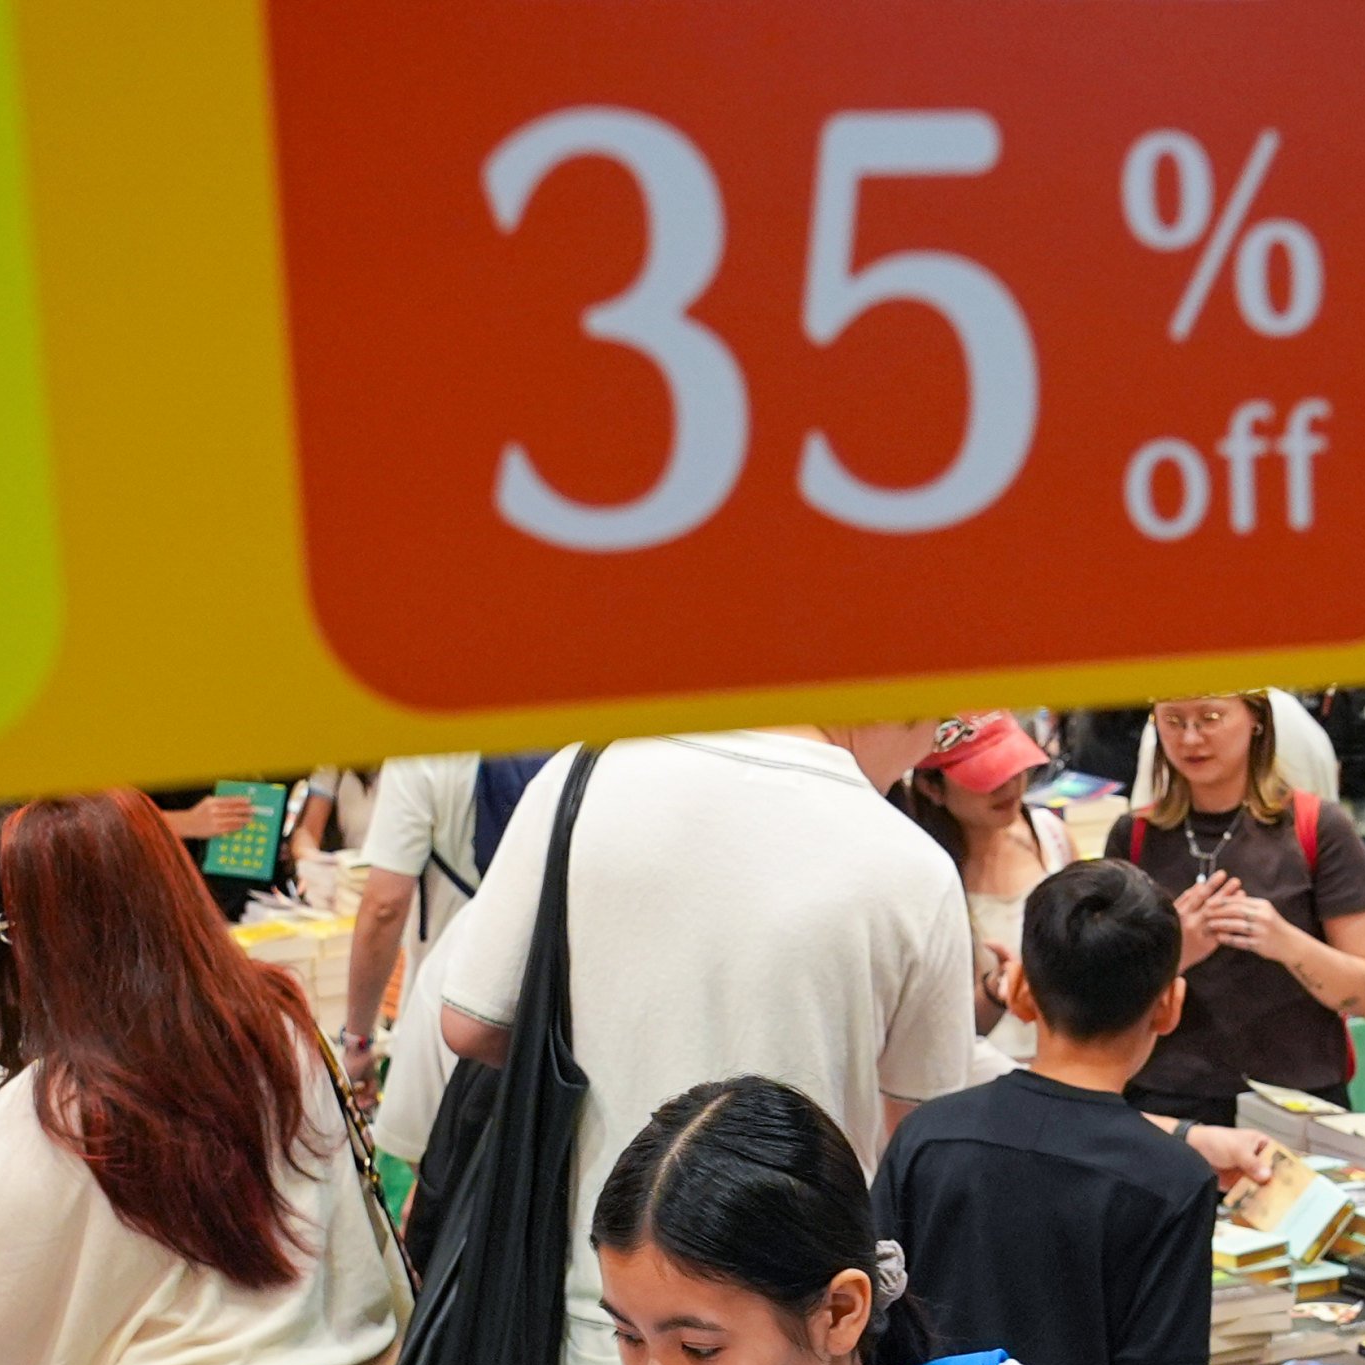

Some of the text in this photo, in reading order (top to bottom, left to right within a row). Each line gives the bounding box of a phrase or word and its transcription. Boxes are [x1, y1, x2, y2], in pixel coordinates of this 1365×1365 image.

[481, 103, 1325, 554] 35 %
[1123, 398, 1331, 541] off
